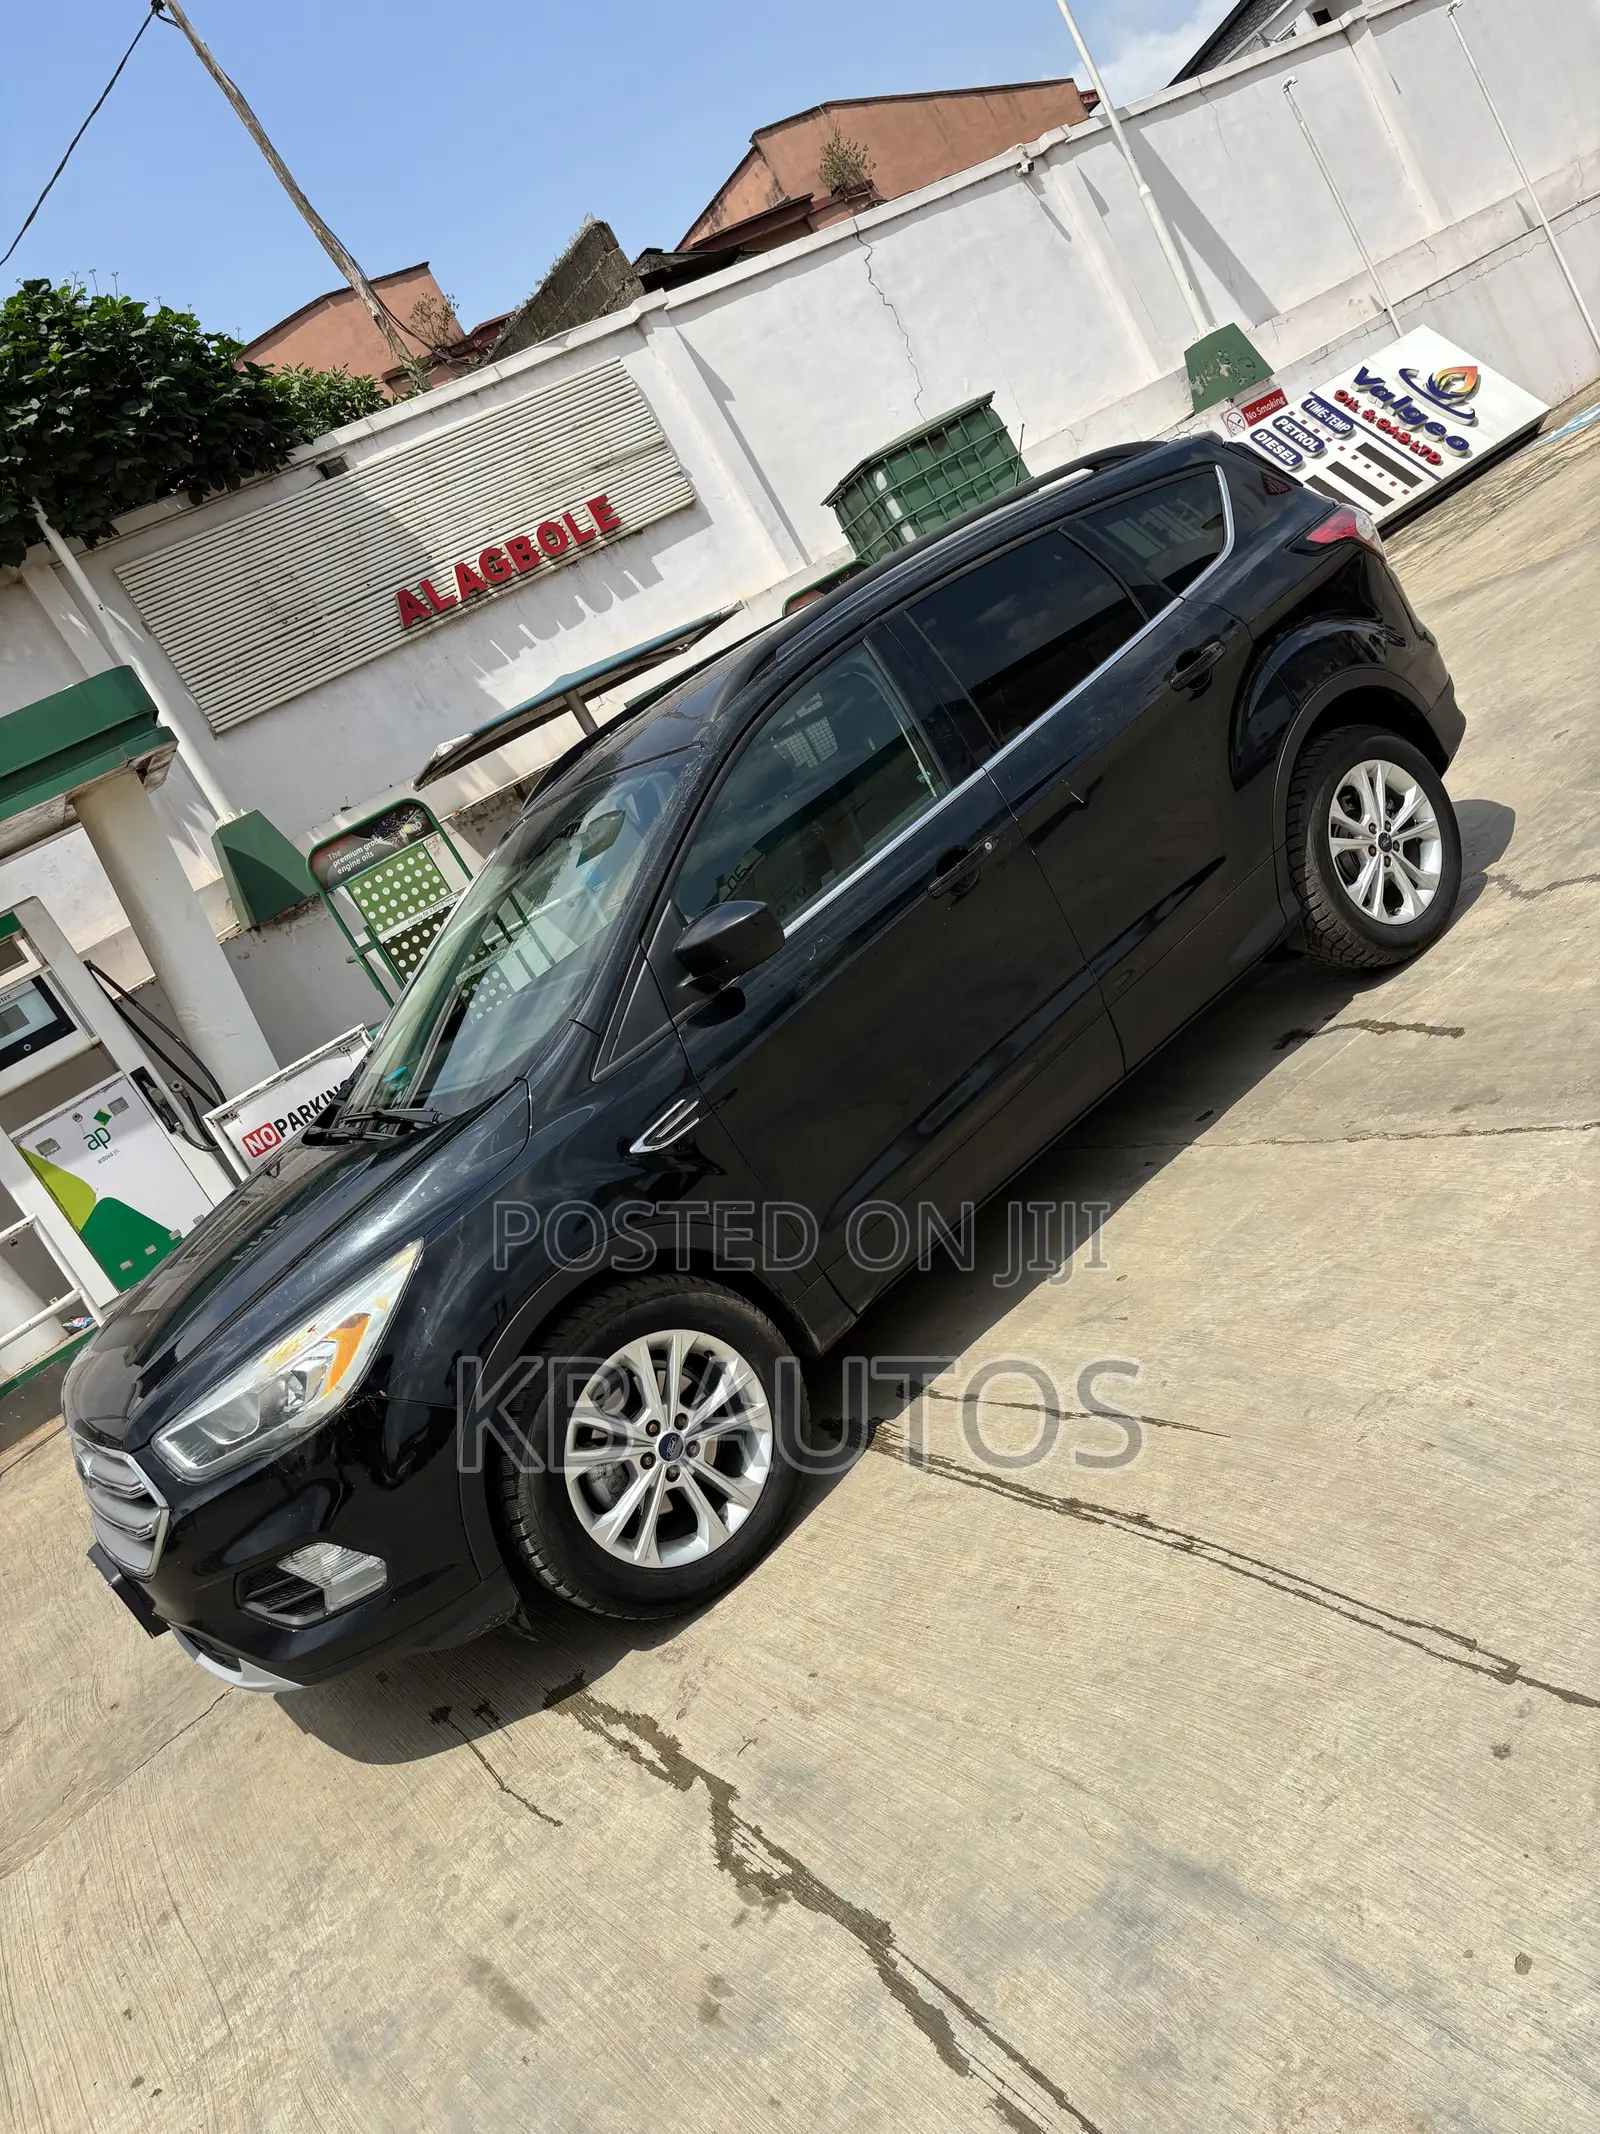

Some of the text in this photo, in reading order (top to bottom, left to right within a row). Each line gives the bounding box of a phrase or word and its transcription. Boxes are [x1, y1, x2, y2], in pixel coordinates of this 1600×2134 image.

[1245, 396, 1286, 421] No Smoking
[1305, 400, 1351, 433] TIME-TEMP
[1351, 366, 1470, 454] Valgeo
[1276, 418, 1318, 451] PETROL
[1334, 389, 1360, 414] OIL
[1361, 408, 1378, 423] &
[1409, 440, 1442, 465] LTD
[1254, 431, 1298, 466] DIESEL
[394, 494, 622, 629] ALAGBOLE
[412, 821, 423, 831] ap
[327, 850, 342, 861] The
[332, 836, 383, 868] premium grade
[337, 850, 375, 875] engine oils
[244, 1079, 347, 1155] NO PARKIN
[83, 1127, 112, 1151] ap
[97, 1152, 113, 1165] ardova
